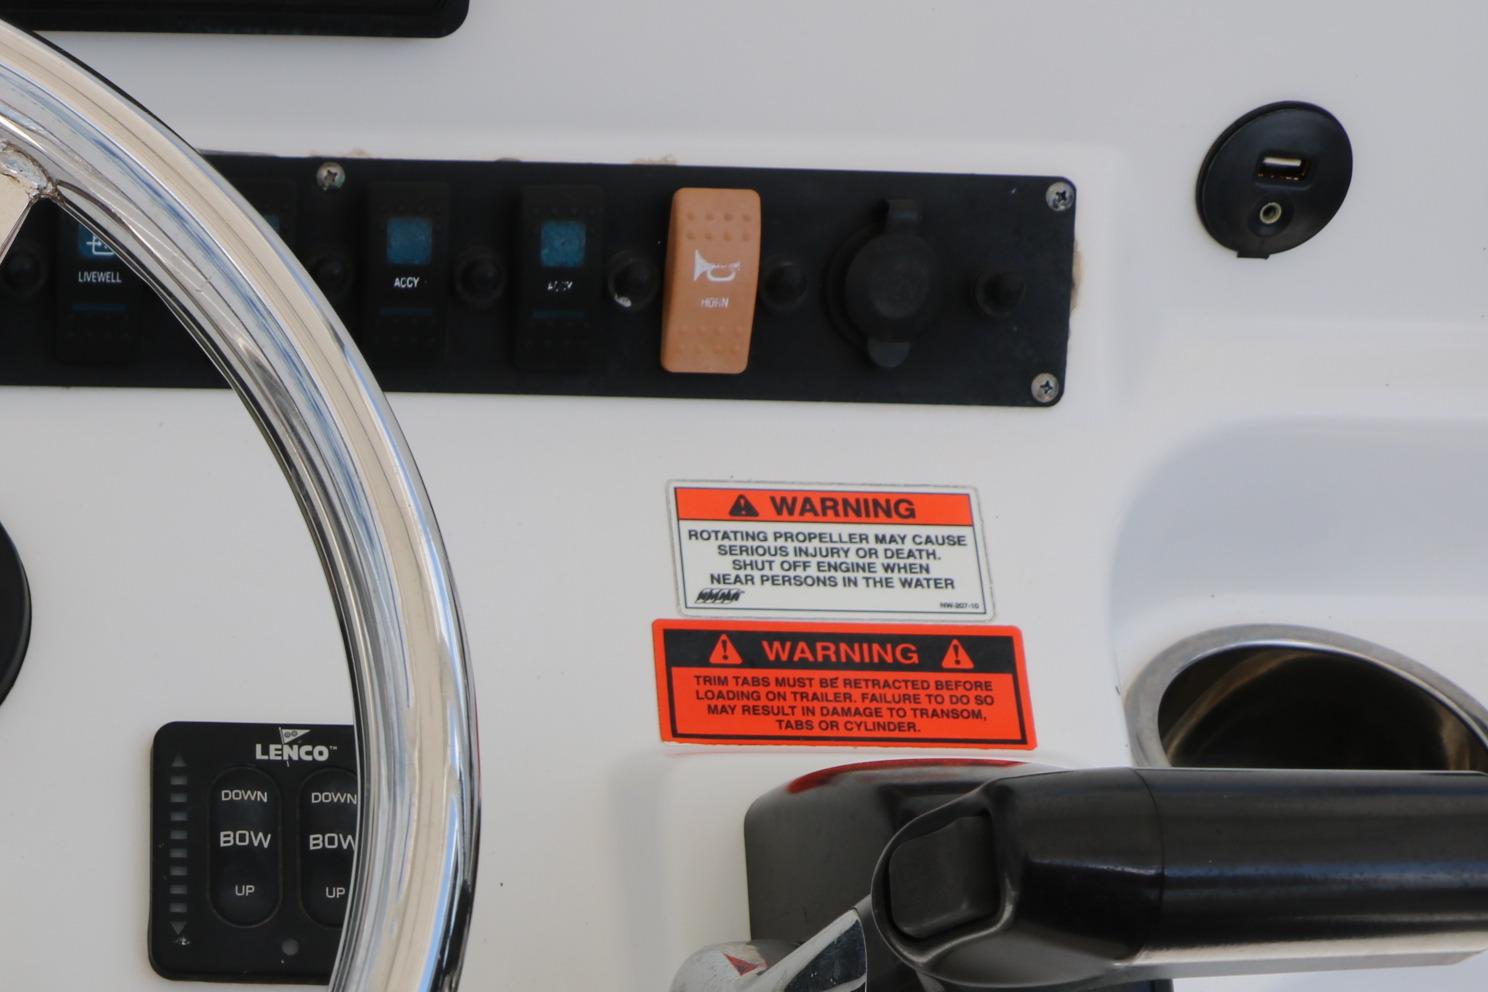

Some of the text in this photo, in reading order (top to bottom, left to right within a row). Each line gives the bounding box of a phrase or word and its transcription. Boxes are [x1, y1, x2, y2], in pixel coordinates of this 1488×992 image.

[78, 271, 122, 283] LIVEWELL
[394, 276, 420, 288] ACCY
[769, 496, 916, 519] WARNING
[687, 529, 967, 546] ROTATING PROPELLER MAY CAUSE
[716, 544, 941, 559] SERIOUS INJURY OR DEATH.
[731, 559, 930, 574] SHUT OFF ENGINE WHEN
[709, 573, 954, 589] NEAR PERSONS IN THE WATER
[761, 640, 919, 665] WARNING
[693, 675, 992, 691] TRIM TABS MUST BE RETRACTED BEFORE
[695, 689, 994, 705] LOADING ON TRAILER. FAILURE TO DO SO
[706, 704, 986, 719] MAY RESULT IN DAMAGE TO TRANSOM,
[775, 719, 920, 732] TABS OR CYLINDER.
[221, 790, 268, 803] DOWN
[311, 792, 357, 804] DOWN
[220, 831, 271, 848] BOW
[310, 833, 356, 850] BOW
[235, 885, 255, 896] UP
[325, 887, 346, 898] UP
